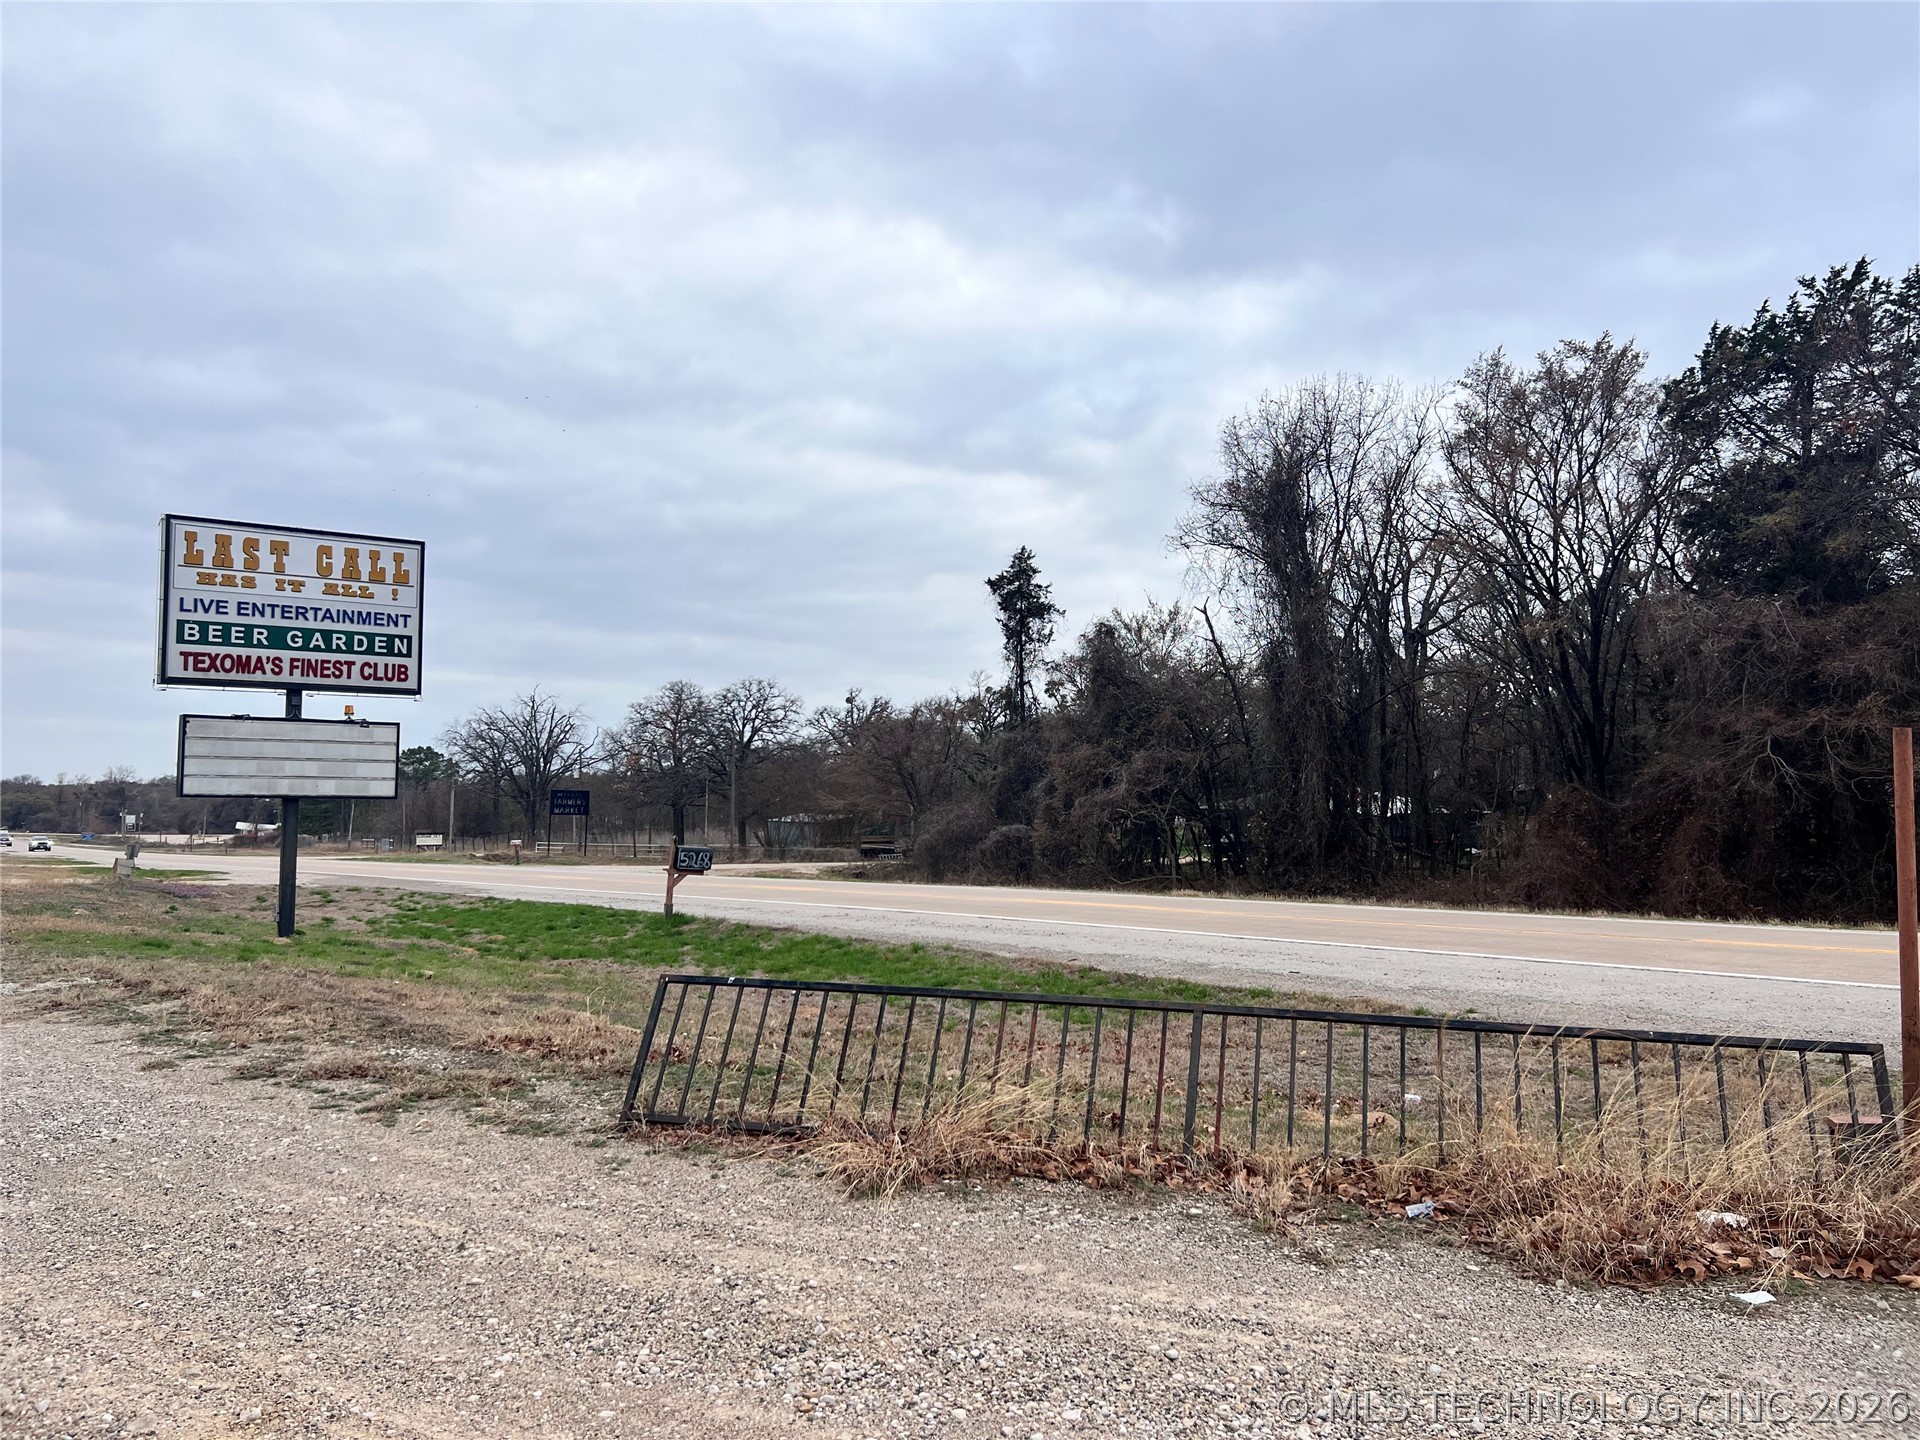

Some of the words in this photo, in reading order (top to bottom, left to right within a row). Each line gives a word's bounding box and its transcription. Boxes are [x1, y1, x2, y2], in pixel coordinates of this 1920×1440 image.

[183, 530, 290, 573] LAST
[316, 544, 410, 584] CALL
[196, 571, 257, 589] HAS
[275, 578, 305, 593] IT
[322, 583, 375, 599] ALL
[179, 597, 229, 616] LIVE
[236, 601, 412, 629] ENTERTAINMENT
[183, 623, 269, 646] BEER
[286, 630, 408, 655] GARDEN
[179, 651, 283, 676] TEXOMA'S
[289, 657, 355, 680] FINEST
[359, 662, 409, 683] CLUB
[554, 806, 585, 814] MARKET
[680, 851, 711, 869] 5268
